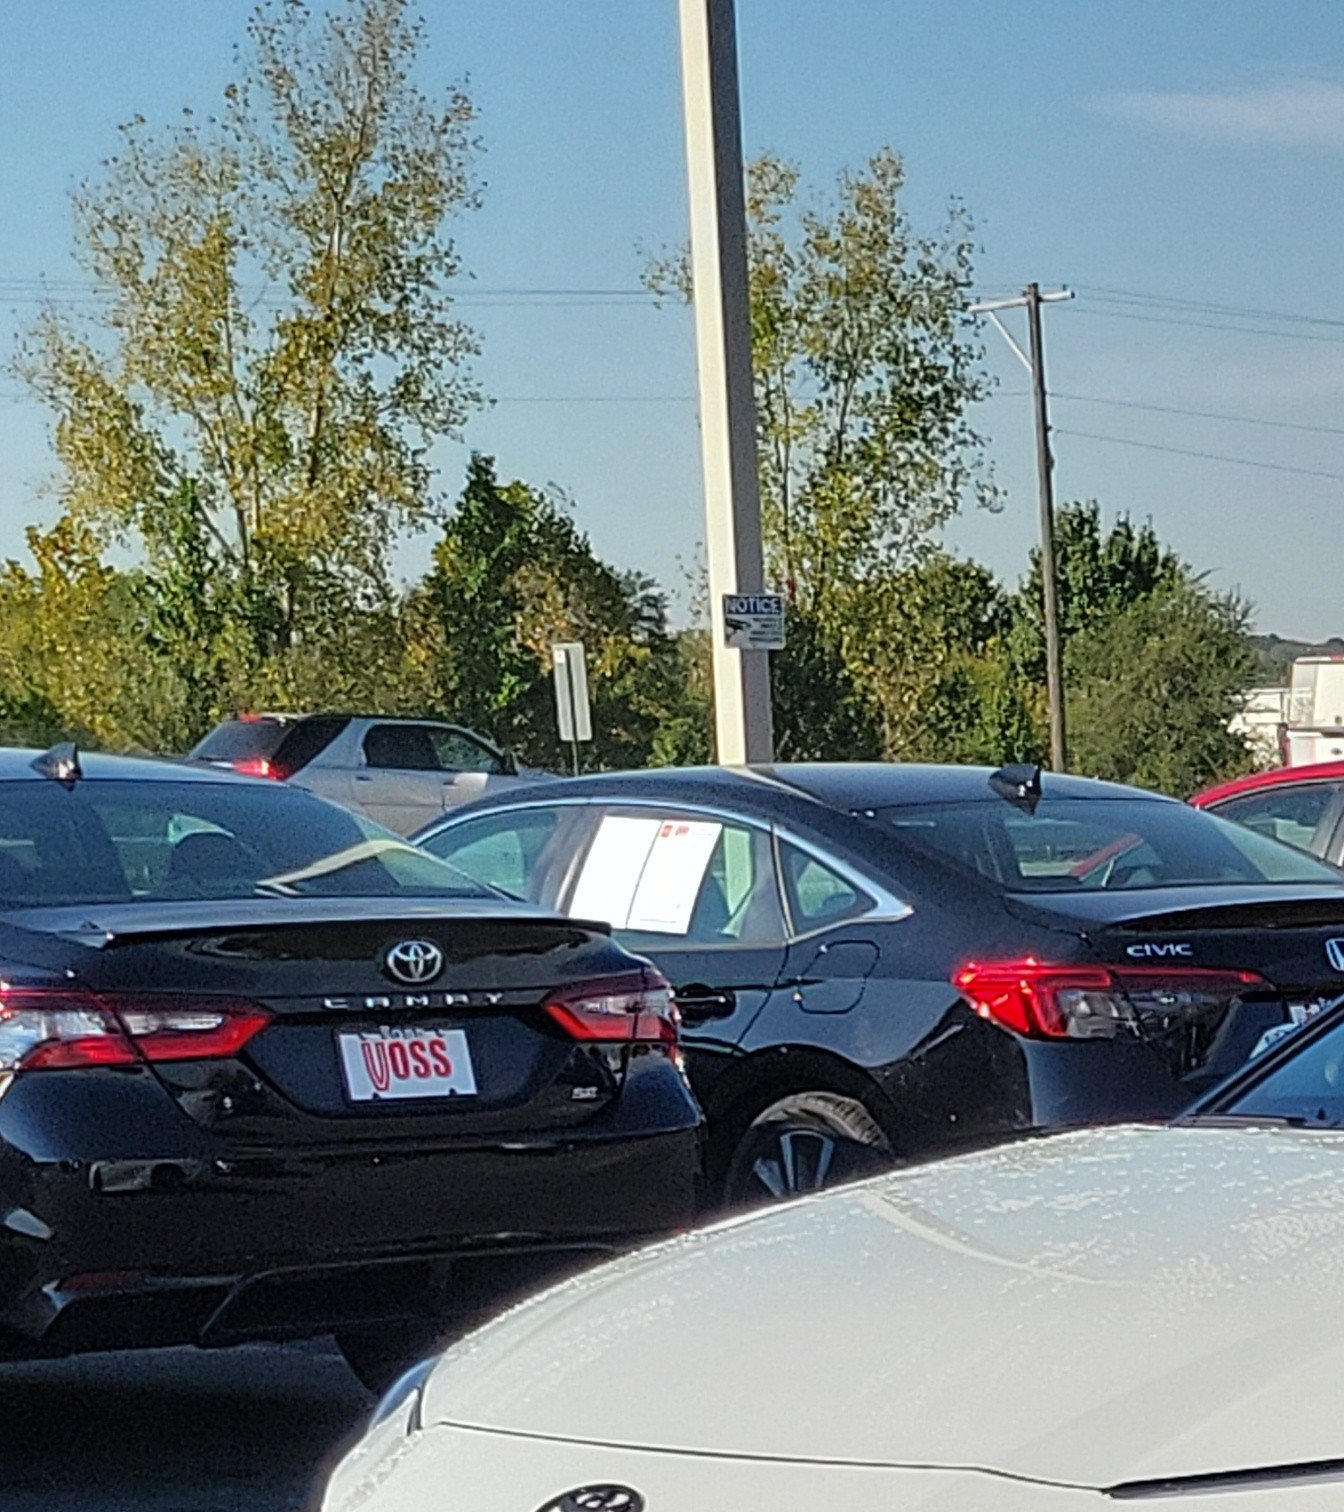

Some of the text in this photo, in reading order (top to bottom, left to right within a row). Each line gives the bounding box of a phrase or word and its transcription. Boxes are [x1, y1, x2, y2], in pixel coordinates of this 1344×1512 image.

[726, 598, 780, 613] NOTICE
[1126, 943, 1194, 958] CIVIC
[324, 992, 504, 1010] CAMRY
[361, 1040, 452, 1091] VOSS
